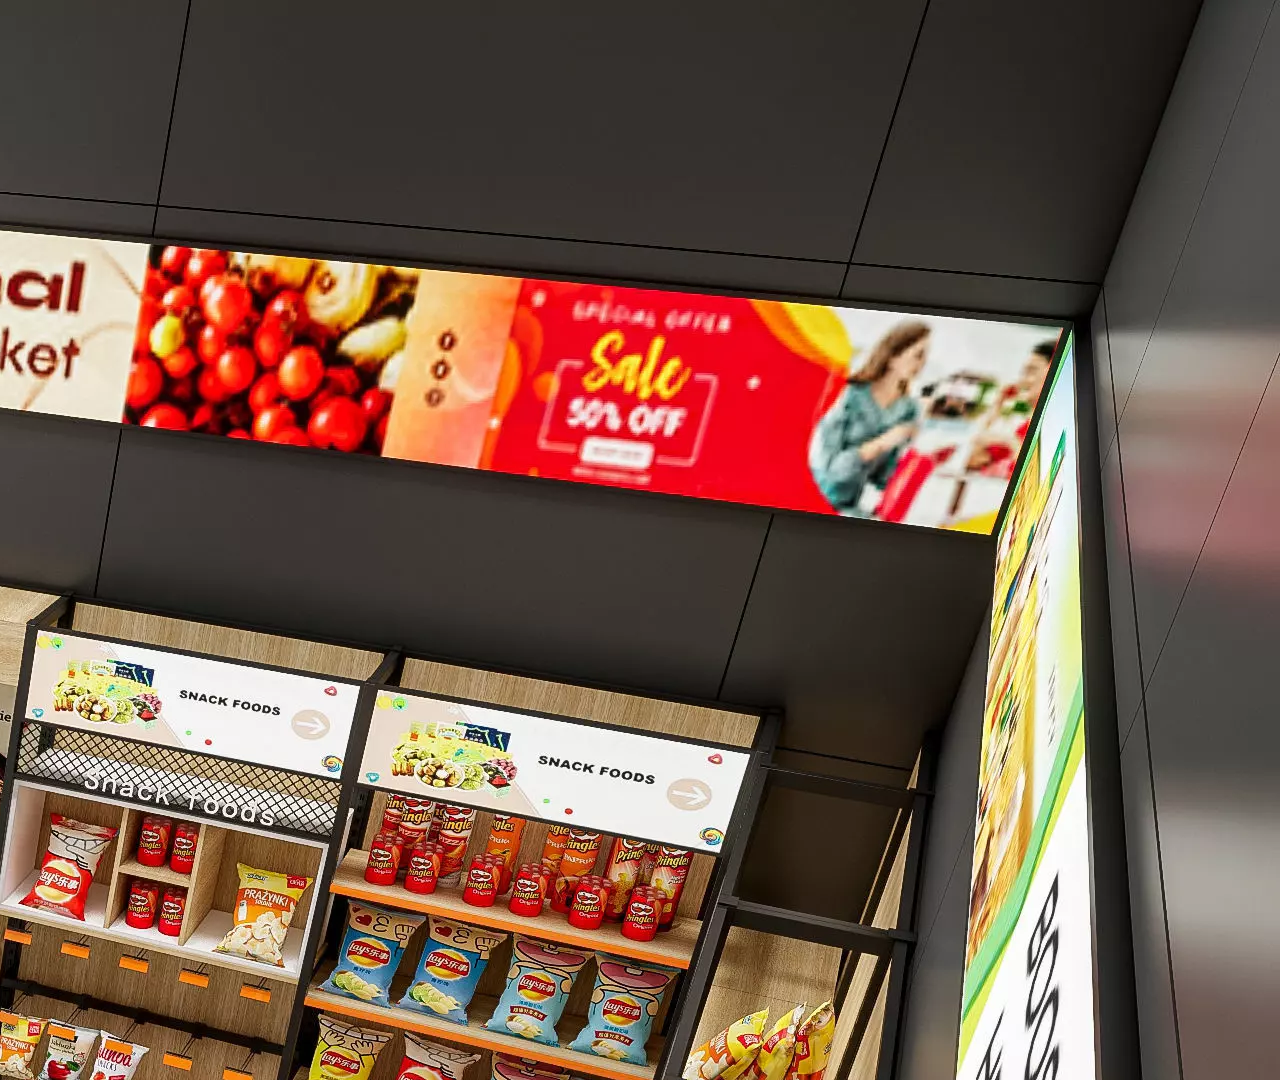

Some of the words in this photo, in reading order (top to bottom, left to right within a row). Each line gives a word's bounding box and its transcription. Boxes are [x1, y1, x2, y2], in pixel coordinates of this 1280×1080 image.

[582, 329, 692, 400] Sale
[566, 397, 622, 431] 50%
[628, 403, 688, 437] OFF
[179, 689, 228, 708] SNACK
[232, 699, 281, 716] FOODS
[538, 755, 594, 774] SNACK
[599, 766, 656, 786] FOODS
[84, 768, 170, 806] Snack
[187, 790, 276, 827] foods
[244, 888, 288, 907] PRAŻYNKI
